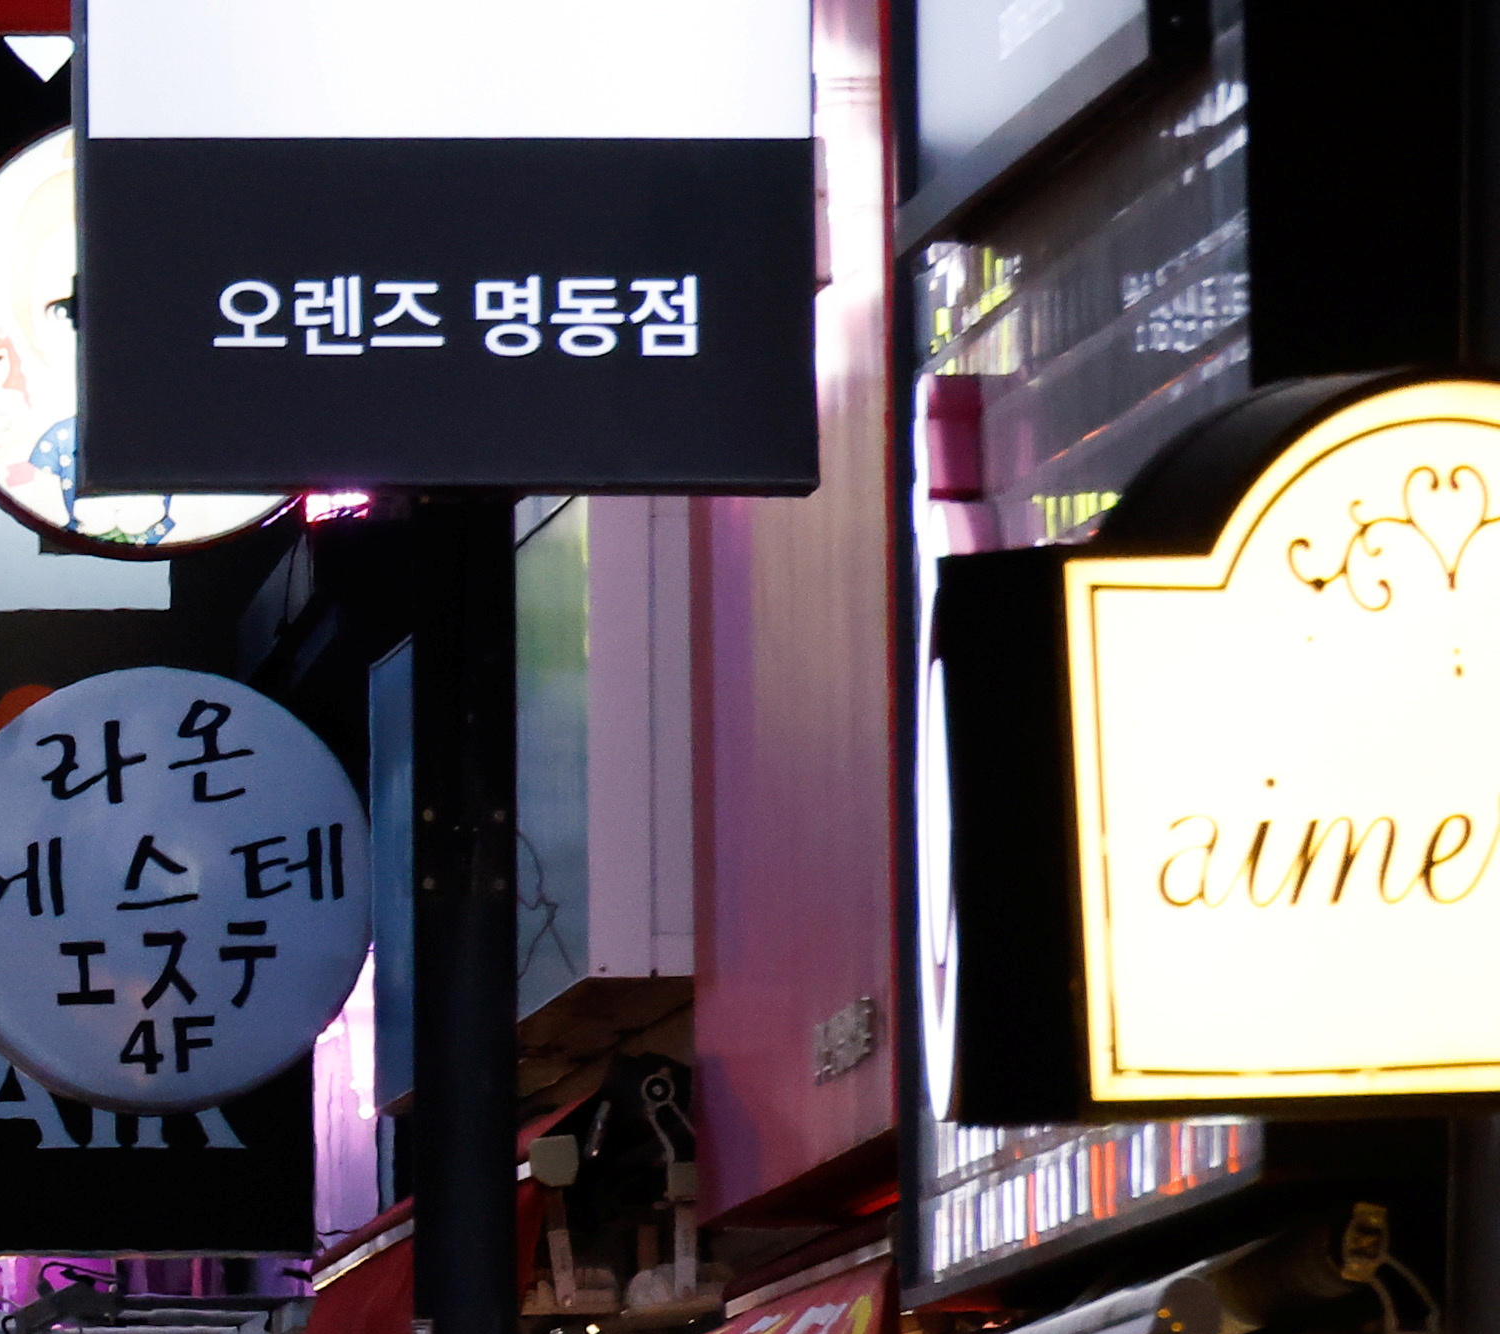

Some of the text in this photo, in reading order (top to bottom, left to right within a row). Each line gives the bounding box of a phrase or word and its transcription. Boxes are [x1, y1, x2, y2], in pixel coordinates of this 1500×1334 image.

[213, 274, 701, 358] 오렌즈 명동점
[36, 697, 254, 806] 라온
[56, 919, 279, 1010] エステ
[119, 1015, 217, 1076] 4F
